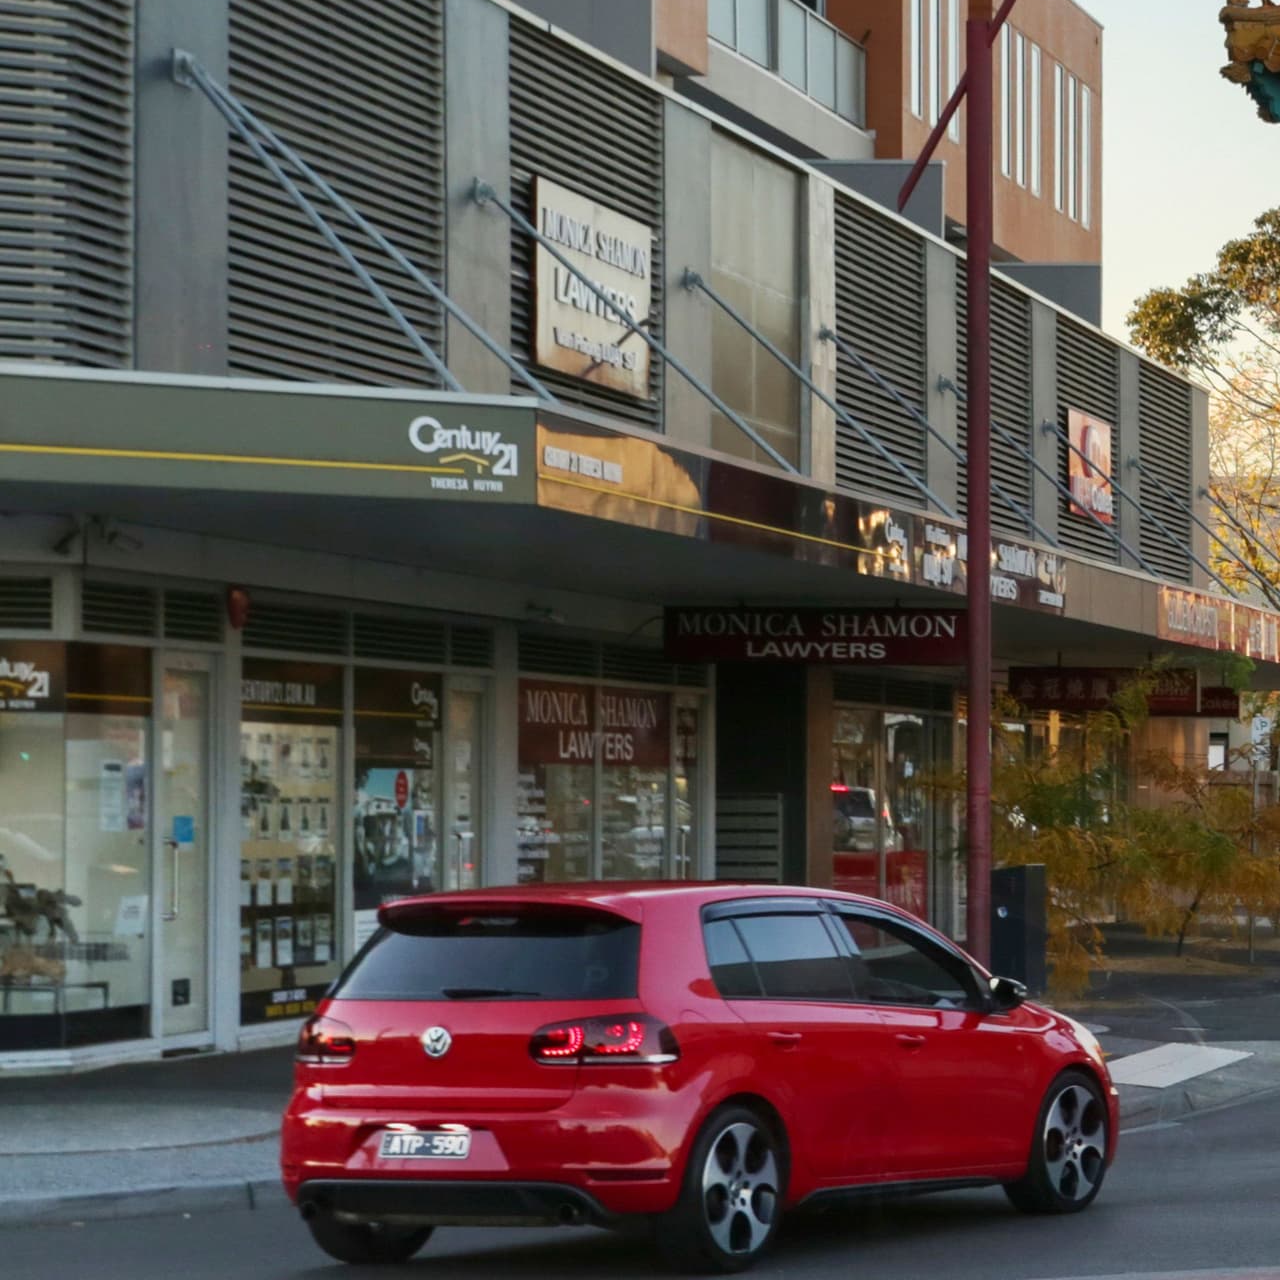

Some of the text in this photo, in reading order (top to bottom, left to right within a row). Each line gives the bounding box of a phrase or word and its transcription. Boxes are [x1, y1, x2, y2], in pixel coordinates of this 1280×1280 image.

[408, 416, 518, 476] Century 21
[431, 476, 469, 491] THERESA
[678, 612, 957, 639] MONICA SHAMON
[746, 641, 887, 659] LAWYERS
[27, 671, 49, 698] 21
[525, 689, 589, 726] MONICA
